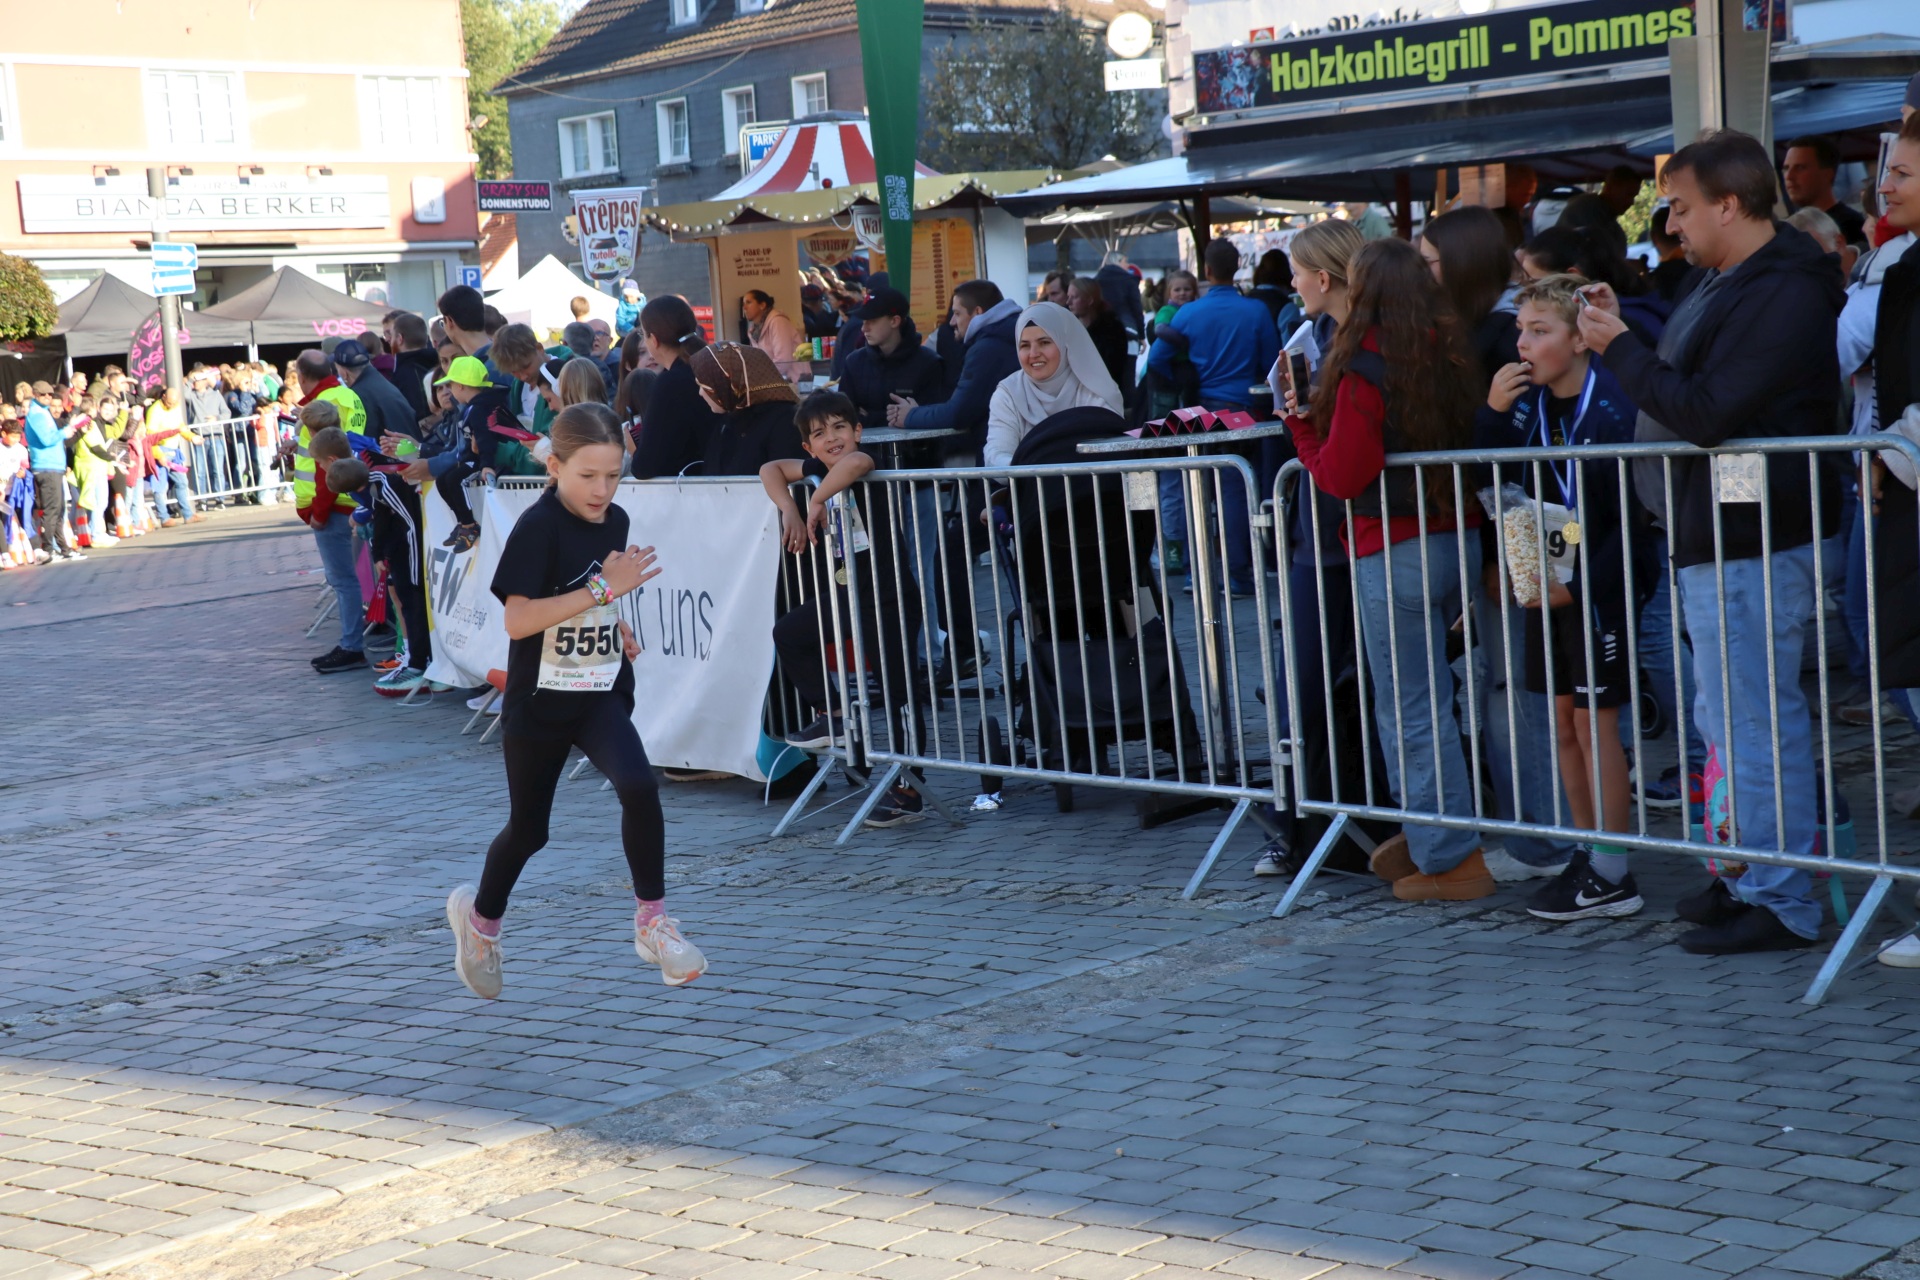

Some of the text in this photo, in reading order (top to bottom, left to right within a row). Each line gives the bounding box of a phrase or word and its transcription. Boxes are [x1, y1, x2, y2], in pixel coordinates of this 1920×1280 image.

[1270, 26, 1490, 93] Holzkohlegrill
[1529, 8, 1692, 60] Pommes
[480, 184, 549, 196] CRAZY SUN
[220, 196, 347, 216] BERKER
[481, 198, 550, 209] SONNENSTUDIO
[578, 197, 638, 236] Crêpes
[590, 249, 617, 260] nutella
[312, 317, 368, 337] VOSS
